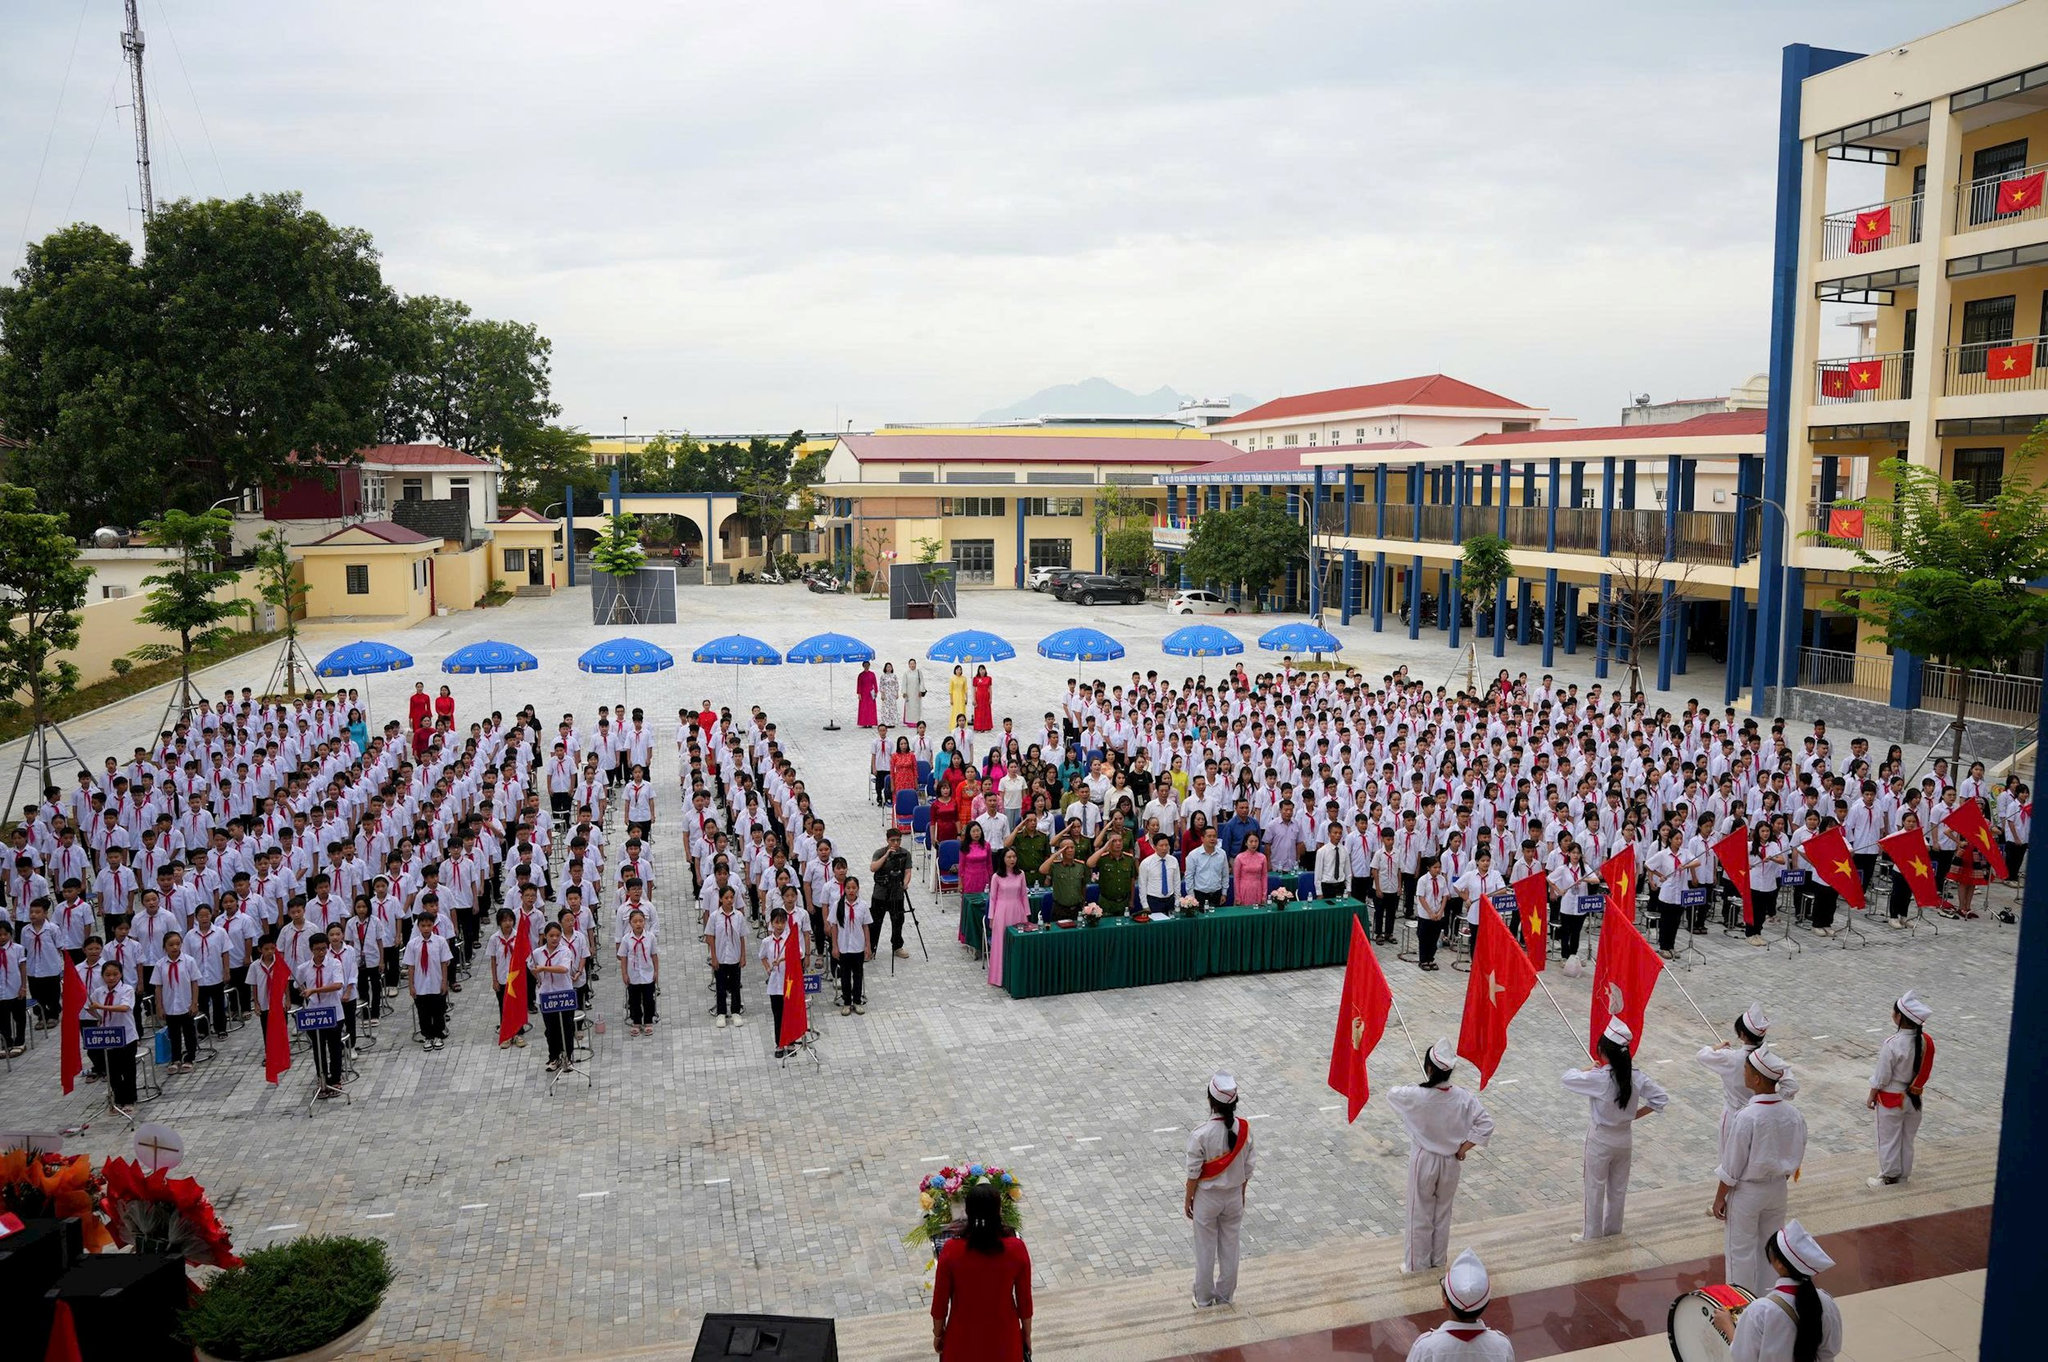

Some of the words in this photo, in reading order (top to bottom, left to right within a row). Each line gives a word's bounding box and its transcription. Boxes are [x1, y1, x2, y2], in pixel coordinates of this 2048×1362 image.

[544, 1000, 558, 1009] LỚP
[560, 999, 575, 1007] 7A2
[300, 1018, 316, 1026] LỚP
[316, 1016, 332, 1025] 7A1
[86, 1036, 103, 1045] LỚP
[104, 1036, 121, 1044] 6A3
